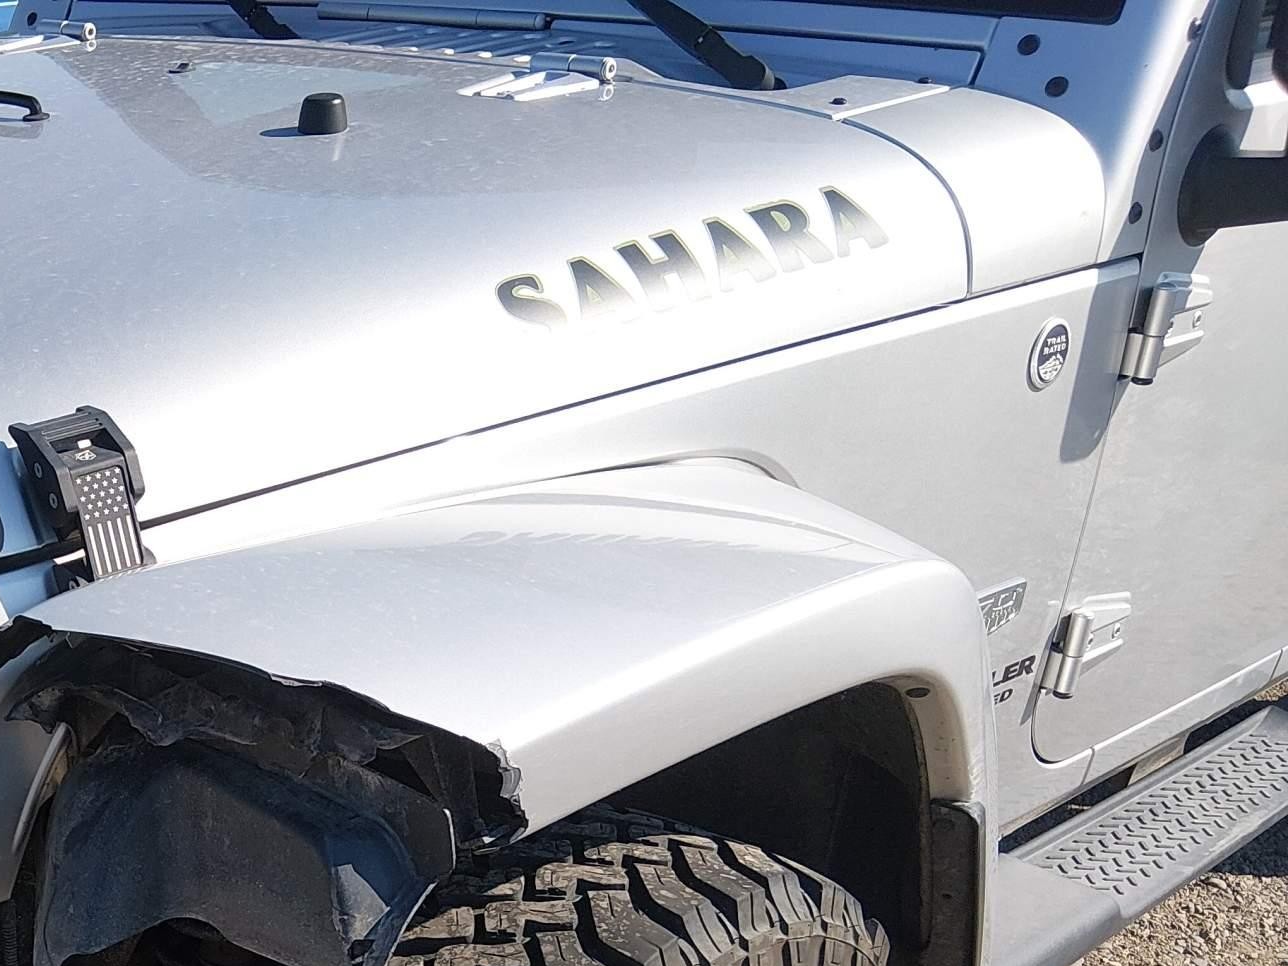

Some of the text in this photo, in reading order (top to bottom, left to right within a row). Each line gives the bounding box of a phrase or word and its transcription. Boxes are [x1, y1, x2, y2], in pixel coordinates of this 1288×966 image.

[494, 185, 891, 334] SAHARA
[1046, 334, 1067, 347] TRAIL
[1042, 343, 1067, 356] RATED
